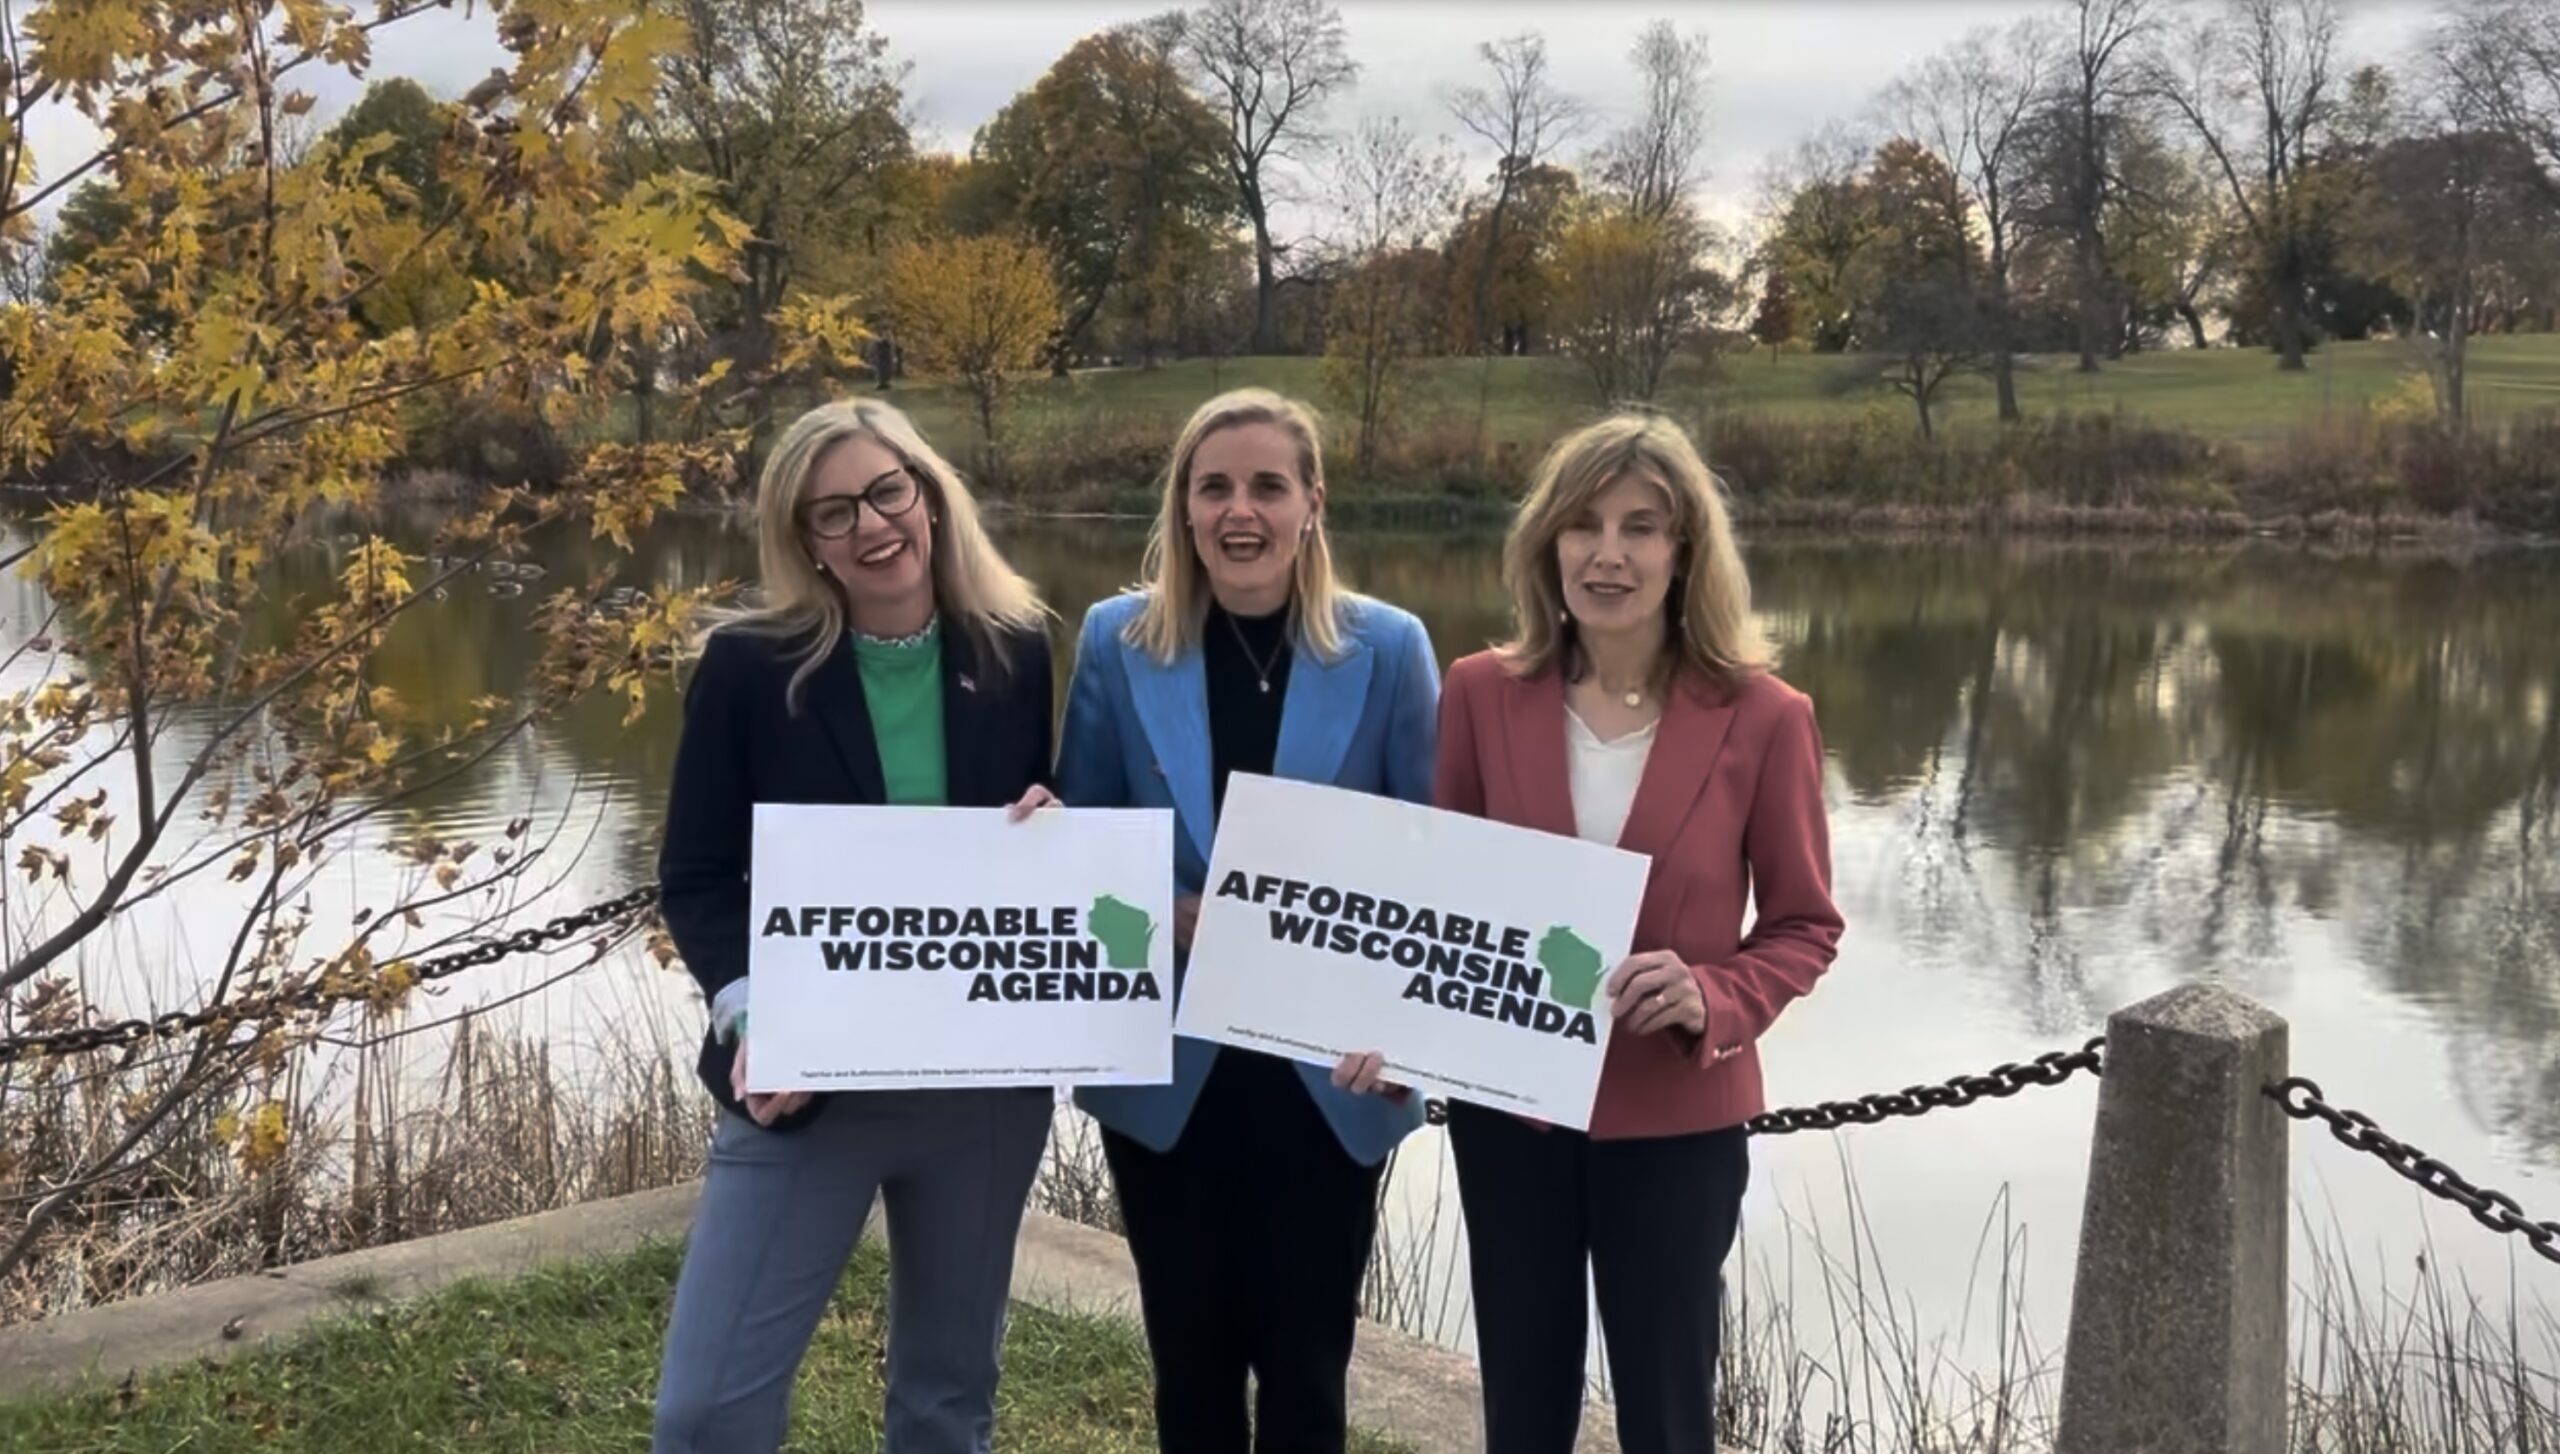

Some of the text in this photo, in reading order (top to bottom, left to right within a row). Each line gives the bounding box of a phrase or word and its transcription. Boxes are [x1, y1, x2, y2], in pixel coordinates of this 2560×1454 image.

[763, 907, 1077, 937] AFFORDABLE
[1217, 870, 1530, 959] AFFORDABLE
[821, 941, 1098, 971] WISCONSIN
[1269, 910, 1543, 997] WISCONSIN
[967, 972, 1161, 1002] AGENDA
[1402, 972, 1597, 1045] AGENDA
